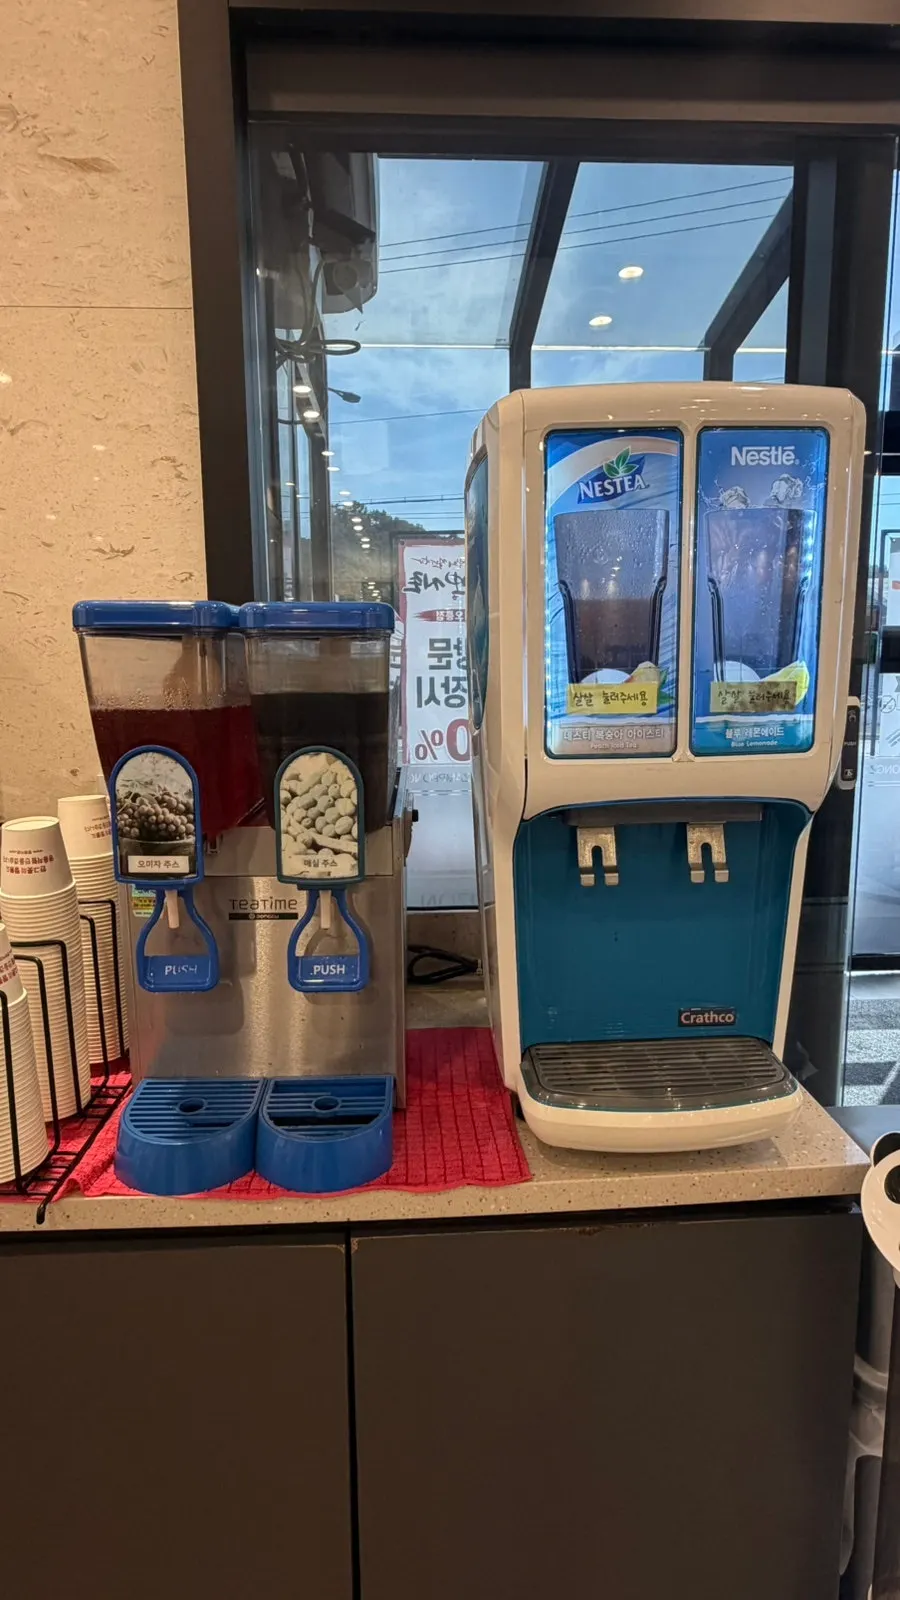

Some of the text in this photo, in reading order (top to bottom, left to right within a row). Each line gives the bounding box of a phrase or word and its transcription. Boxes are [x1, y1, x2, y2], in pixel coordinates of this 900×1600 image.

[578, 472, 647, 500] NESTEA
[573, 692, 594, 707] 살살
[595, 729, 624, 740] 복숭아
[627, 728, 665, 739] 아이스티
[725, 726, 785, 739] 블루 레몬에이드
[137, 860, 181, 869] 오미자 주스
[303, 859, 338, 868] 매실 주스
[312, 964, 346, 975] PUSH
[680, 1010, 735, 1024] Crathco
